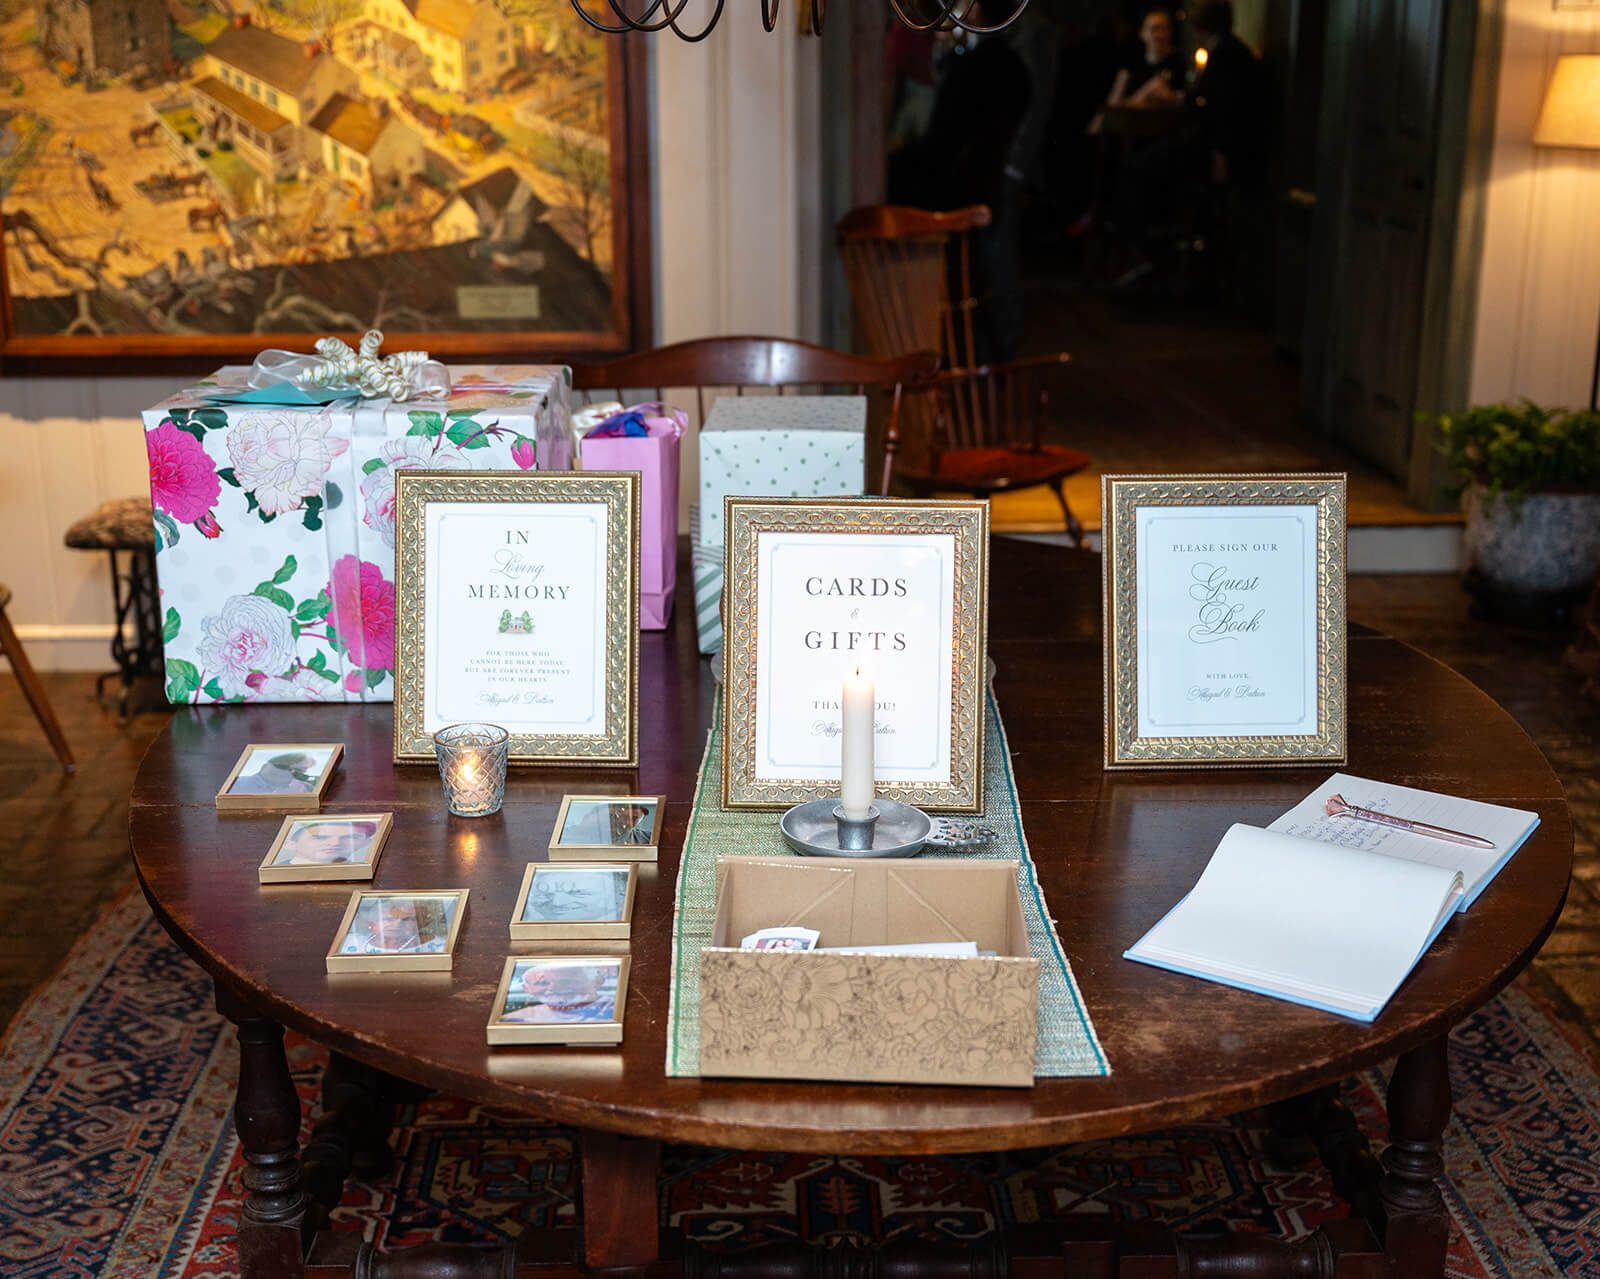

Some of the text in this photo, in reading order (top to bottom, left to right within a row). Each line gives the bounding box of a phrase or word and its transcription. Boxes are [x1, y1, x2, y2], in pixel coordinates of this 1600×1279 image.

[506, 530, 529, 544] IN
[1173, 543, 1279, 552] PLEASE SIGN OUR
[488, 548, 544, 582] Loving
[805, 576, 907, 597] CARDS
[1188, 561, 1260, 601] Guest
[467, 584, 570, 600] MEMORY
[849, 607, 860, 619] &
[1187, 592, 1266, 644] Book
[804, 630, 907, 651] GIFTS
[812, 701, 896, 711] THA OU!
